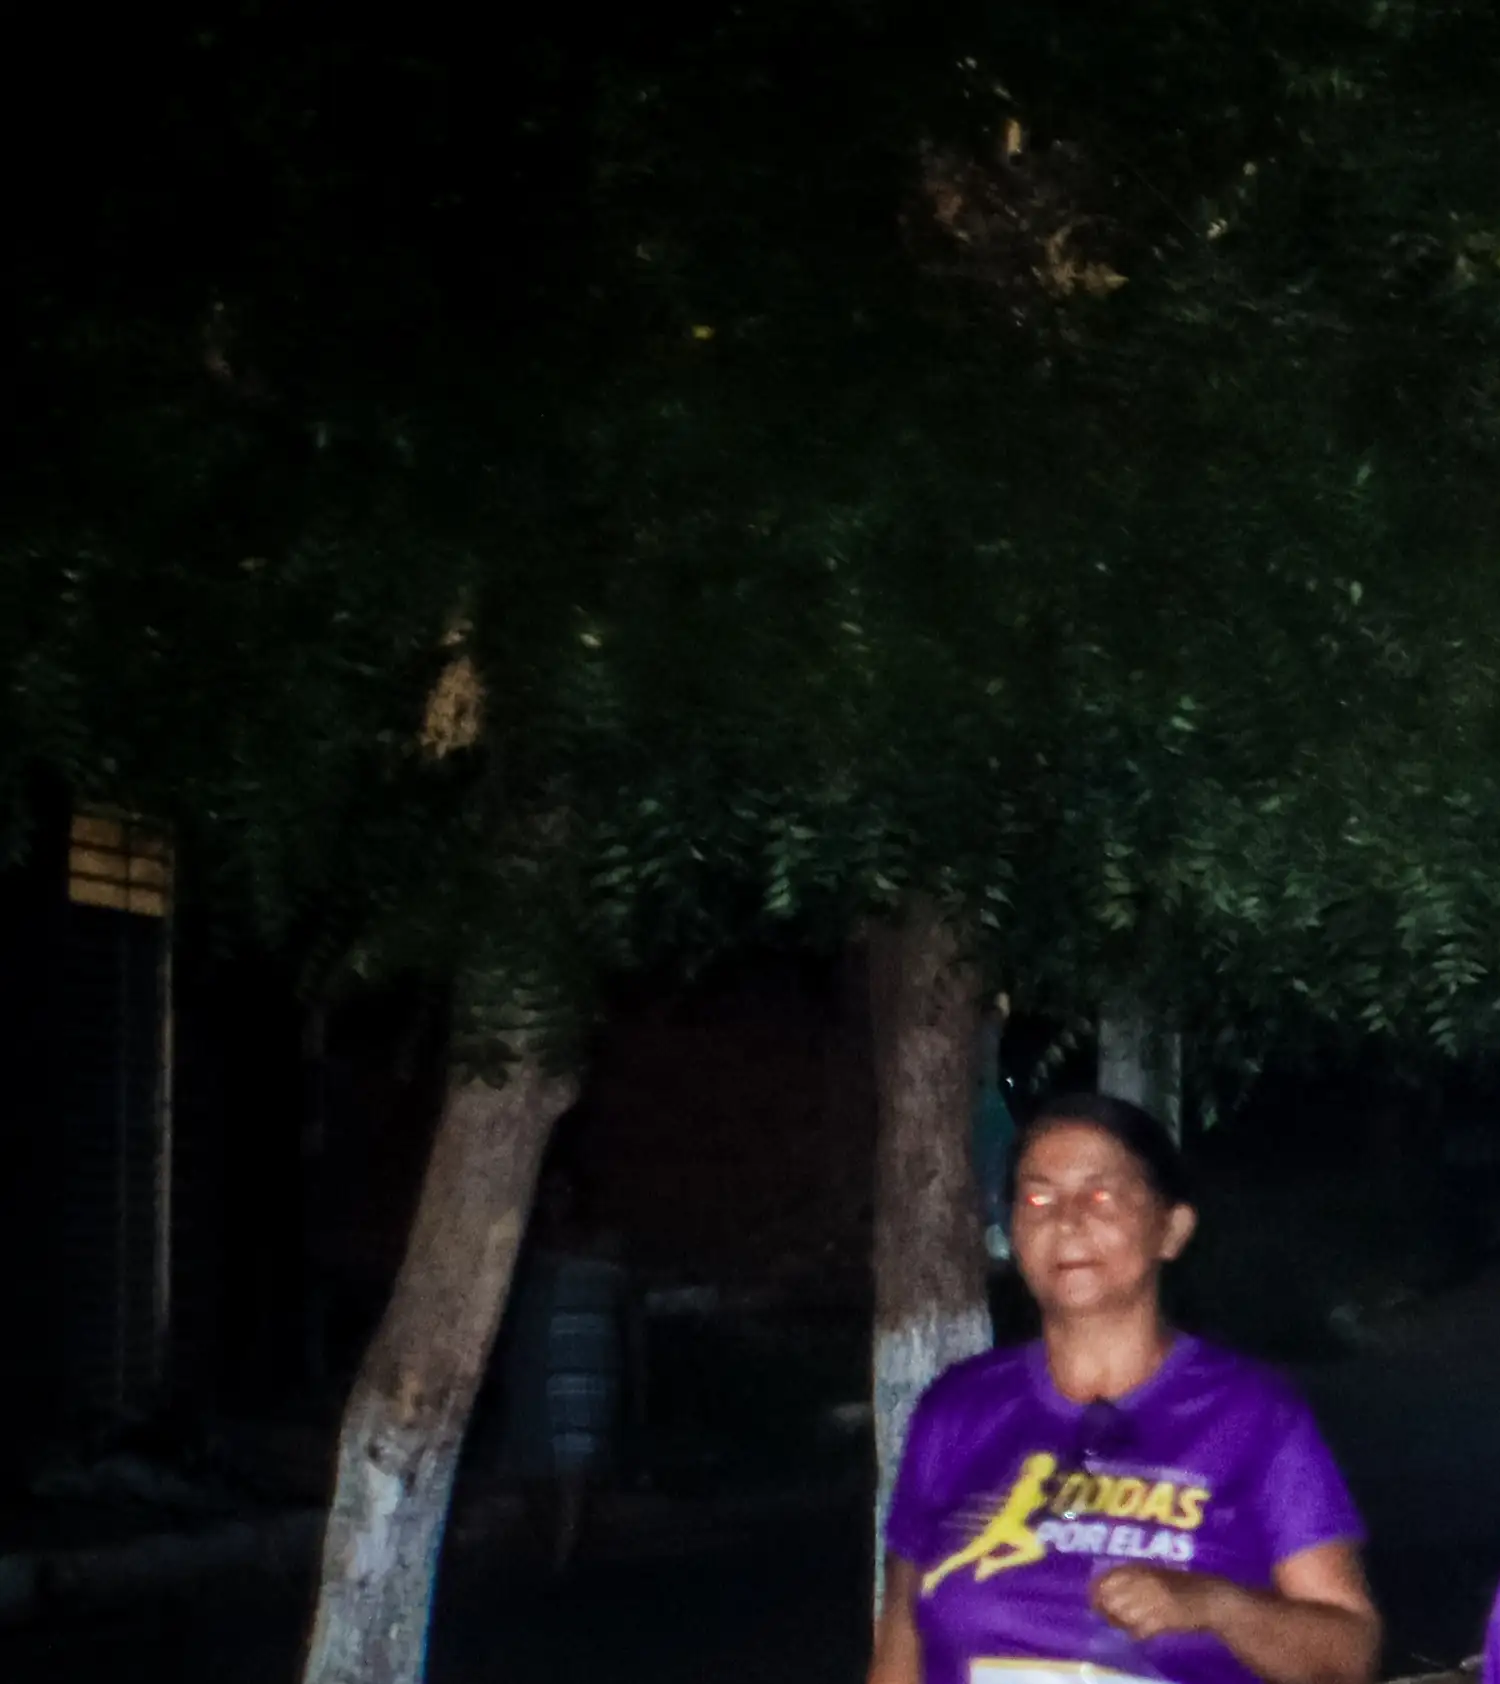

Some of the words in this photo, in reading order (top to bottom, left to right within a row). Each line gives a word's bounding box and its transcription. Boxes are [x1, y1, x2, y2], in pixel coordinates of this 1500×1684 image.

[1050, 1473, 1212, 1531] TODAS
[1036, 1520, 1109, 1554] POR
[1106, 1525, 1194, 1562] ELAS
